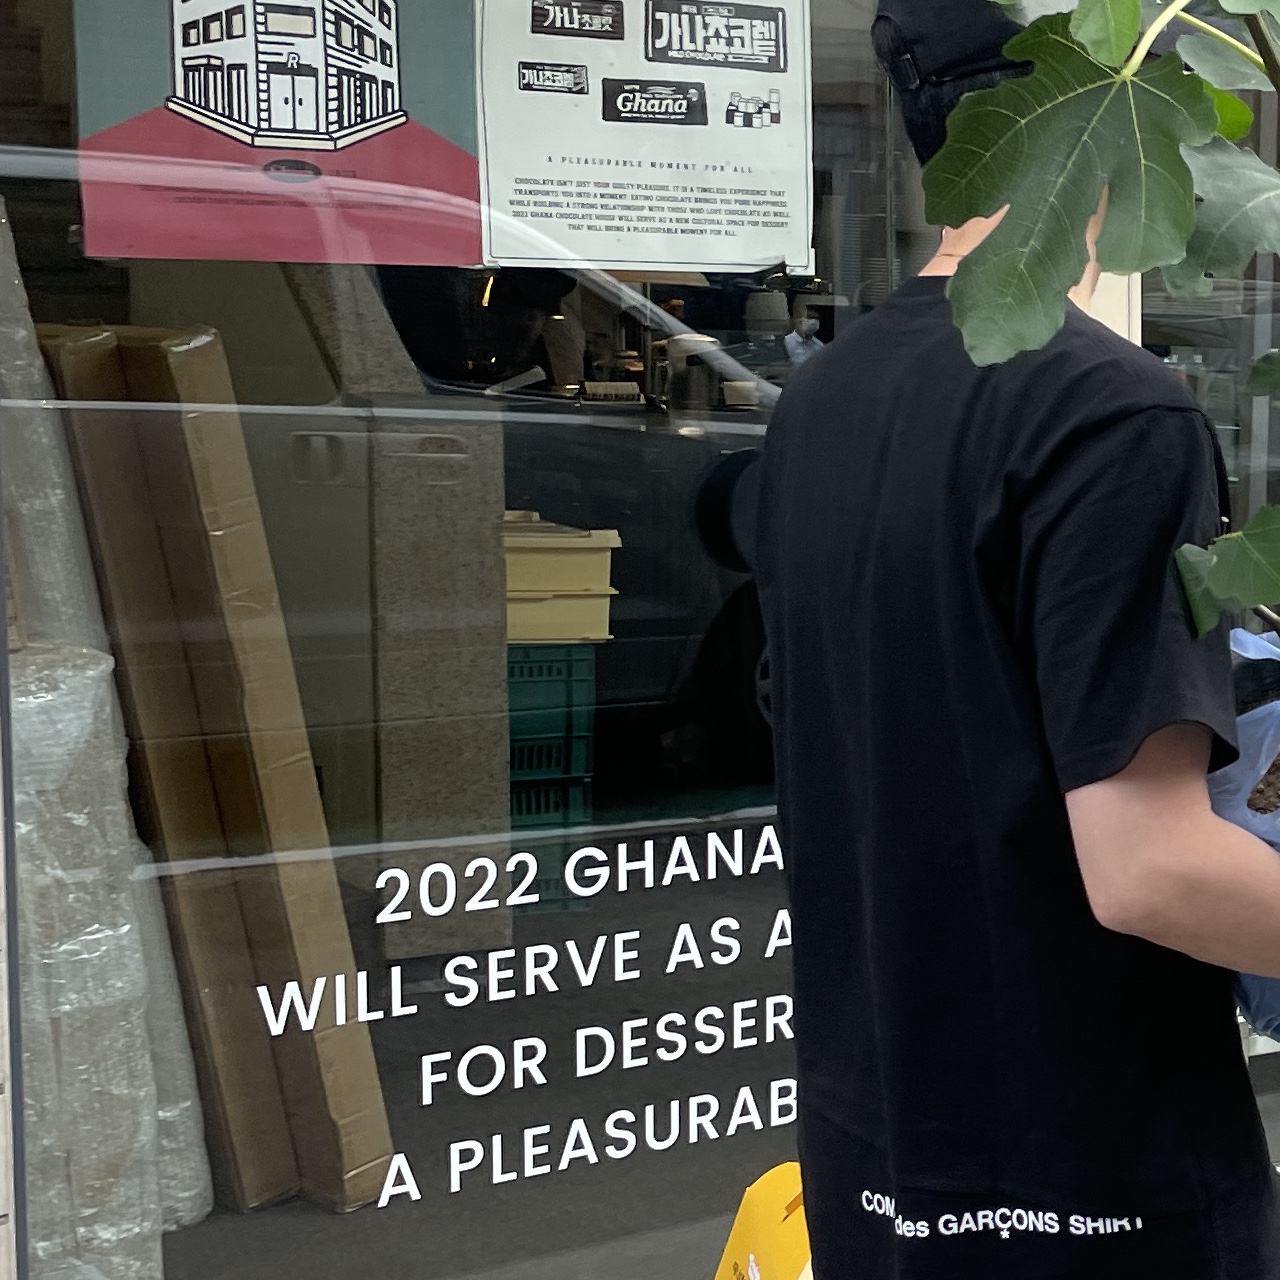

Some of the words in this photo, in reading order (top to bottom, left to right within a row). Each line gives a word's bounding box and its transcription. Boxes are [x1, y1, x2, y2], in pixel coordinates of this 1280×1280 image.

[616, 92, 688, 113] Ghana
[374, 852, 541, 925] 2022
[563, 824, 786, 898] GHANA
[255, 965, 418, 1038] WILL
[443, 930, 642, 1008] SERVE
[665, 916, 742, 974] AS
[764, 908, 793, 959] A
[420, 1036, 549, 1107] FOR
[575, 993, 796, 1079] DESSER
[376, 1152, 423, 1209] A
[449, 1077, 799, 1194] PLEASURAB
[894, 1214, 930, 1238] des
